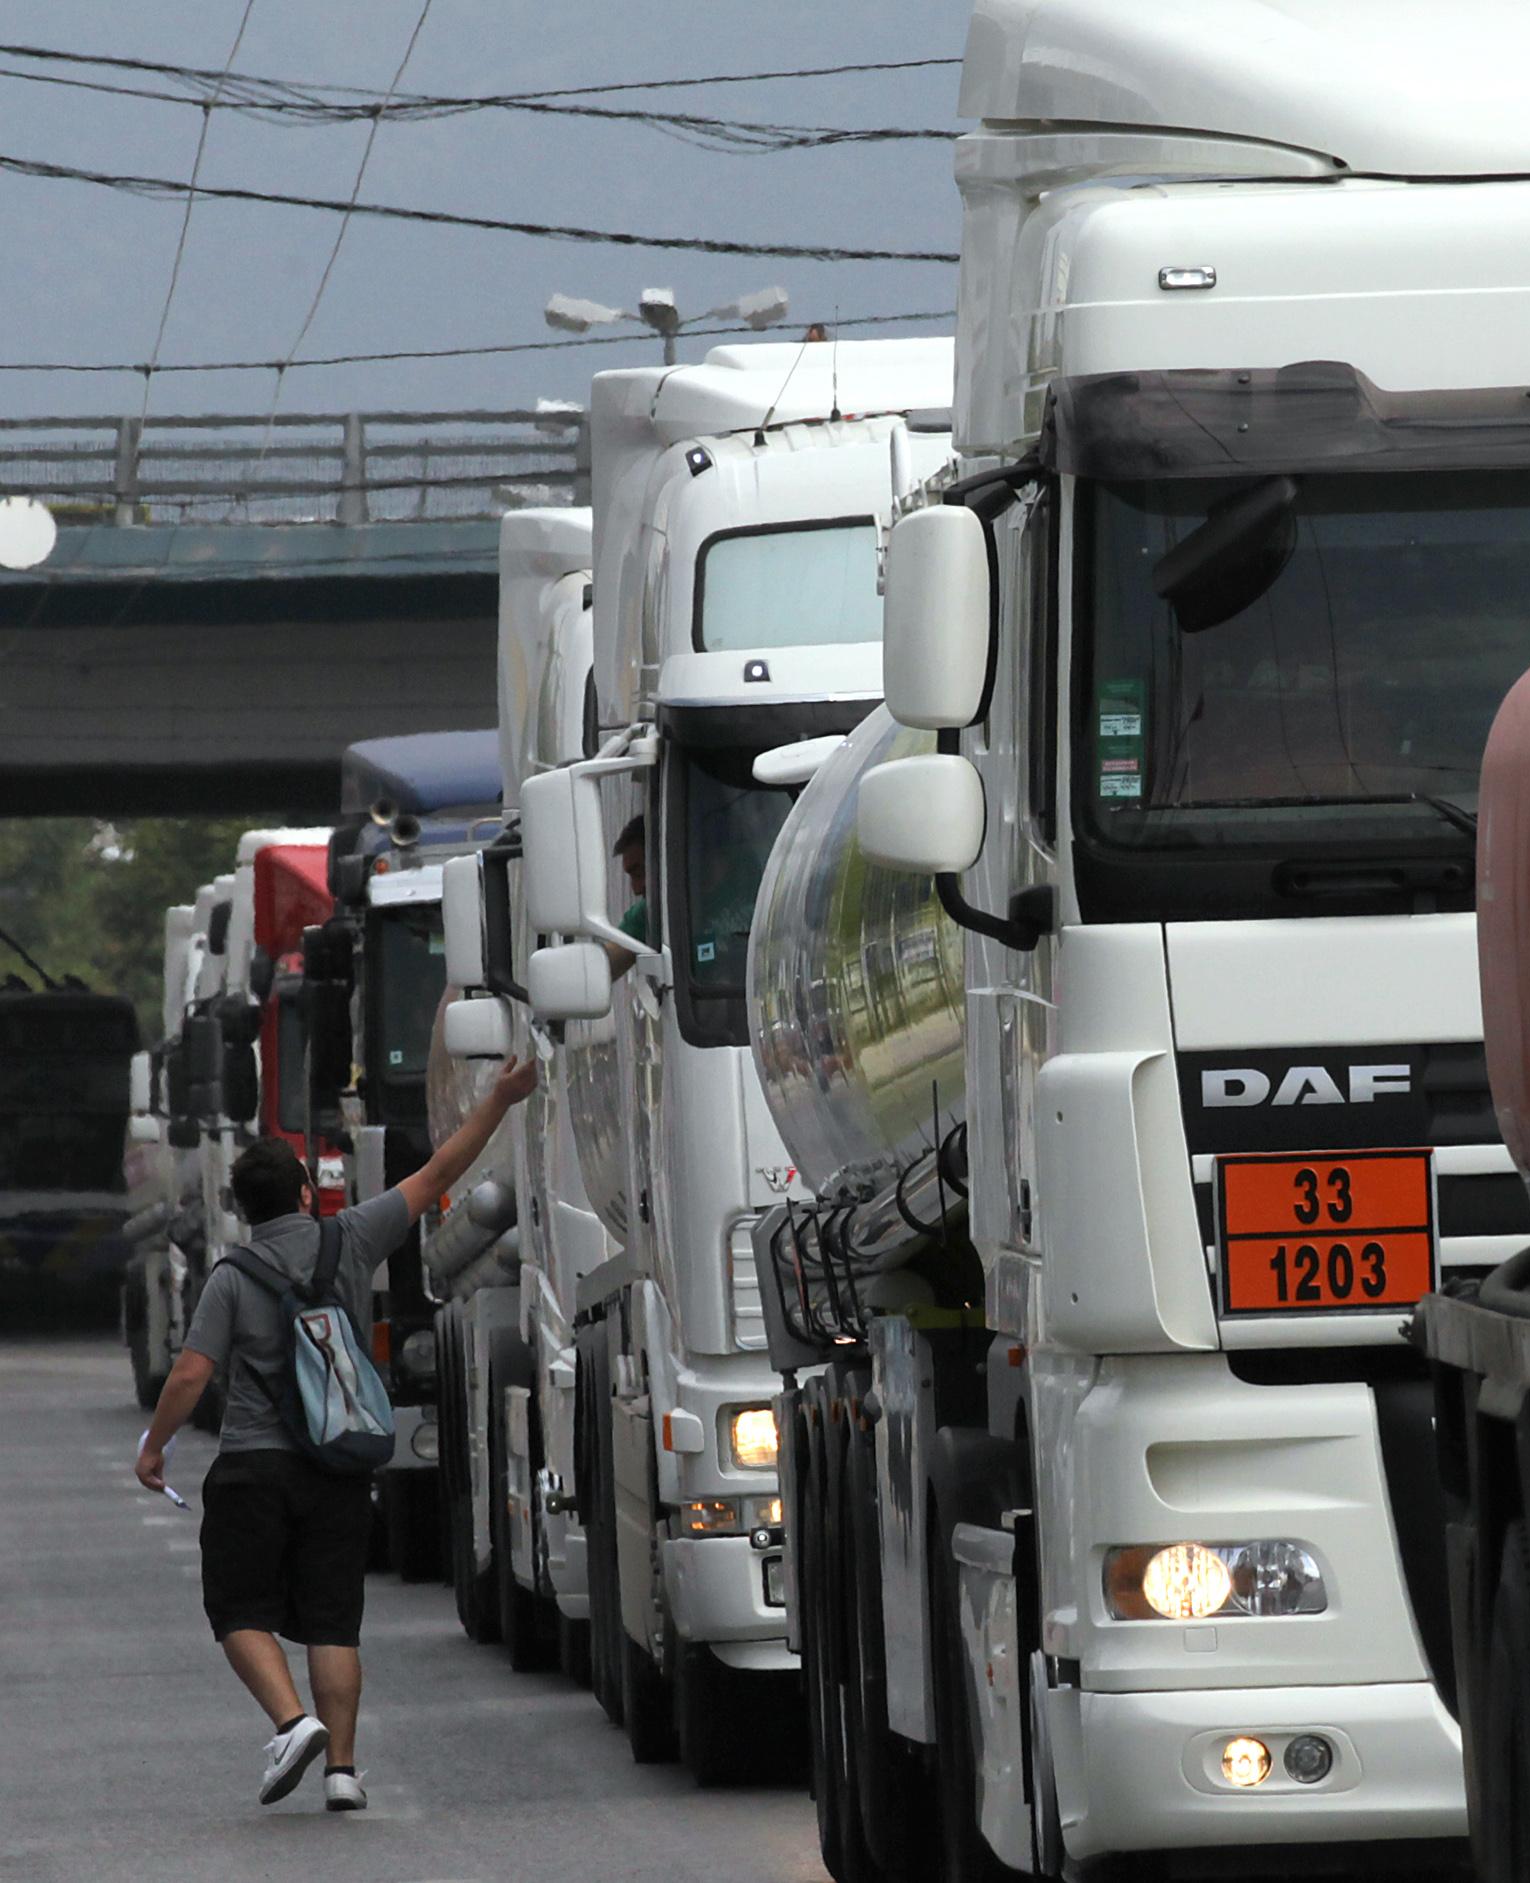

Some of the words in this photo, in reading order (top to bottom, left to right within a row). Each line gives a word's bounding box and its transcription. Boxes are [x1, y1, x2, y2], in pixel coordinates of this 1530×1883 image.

[1201, 1064, 1410, 1107] DAF
[1294, 1168, 1352, 1225] 33
[1271, 1242, 1386, 1302] 1203
